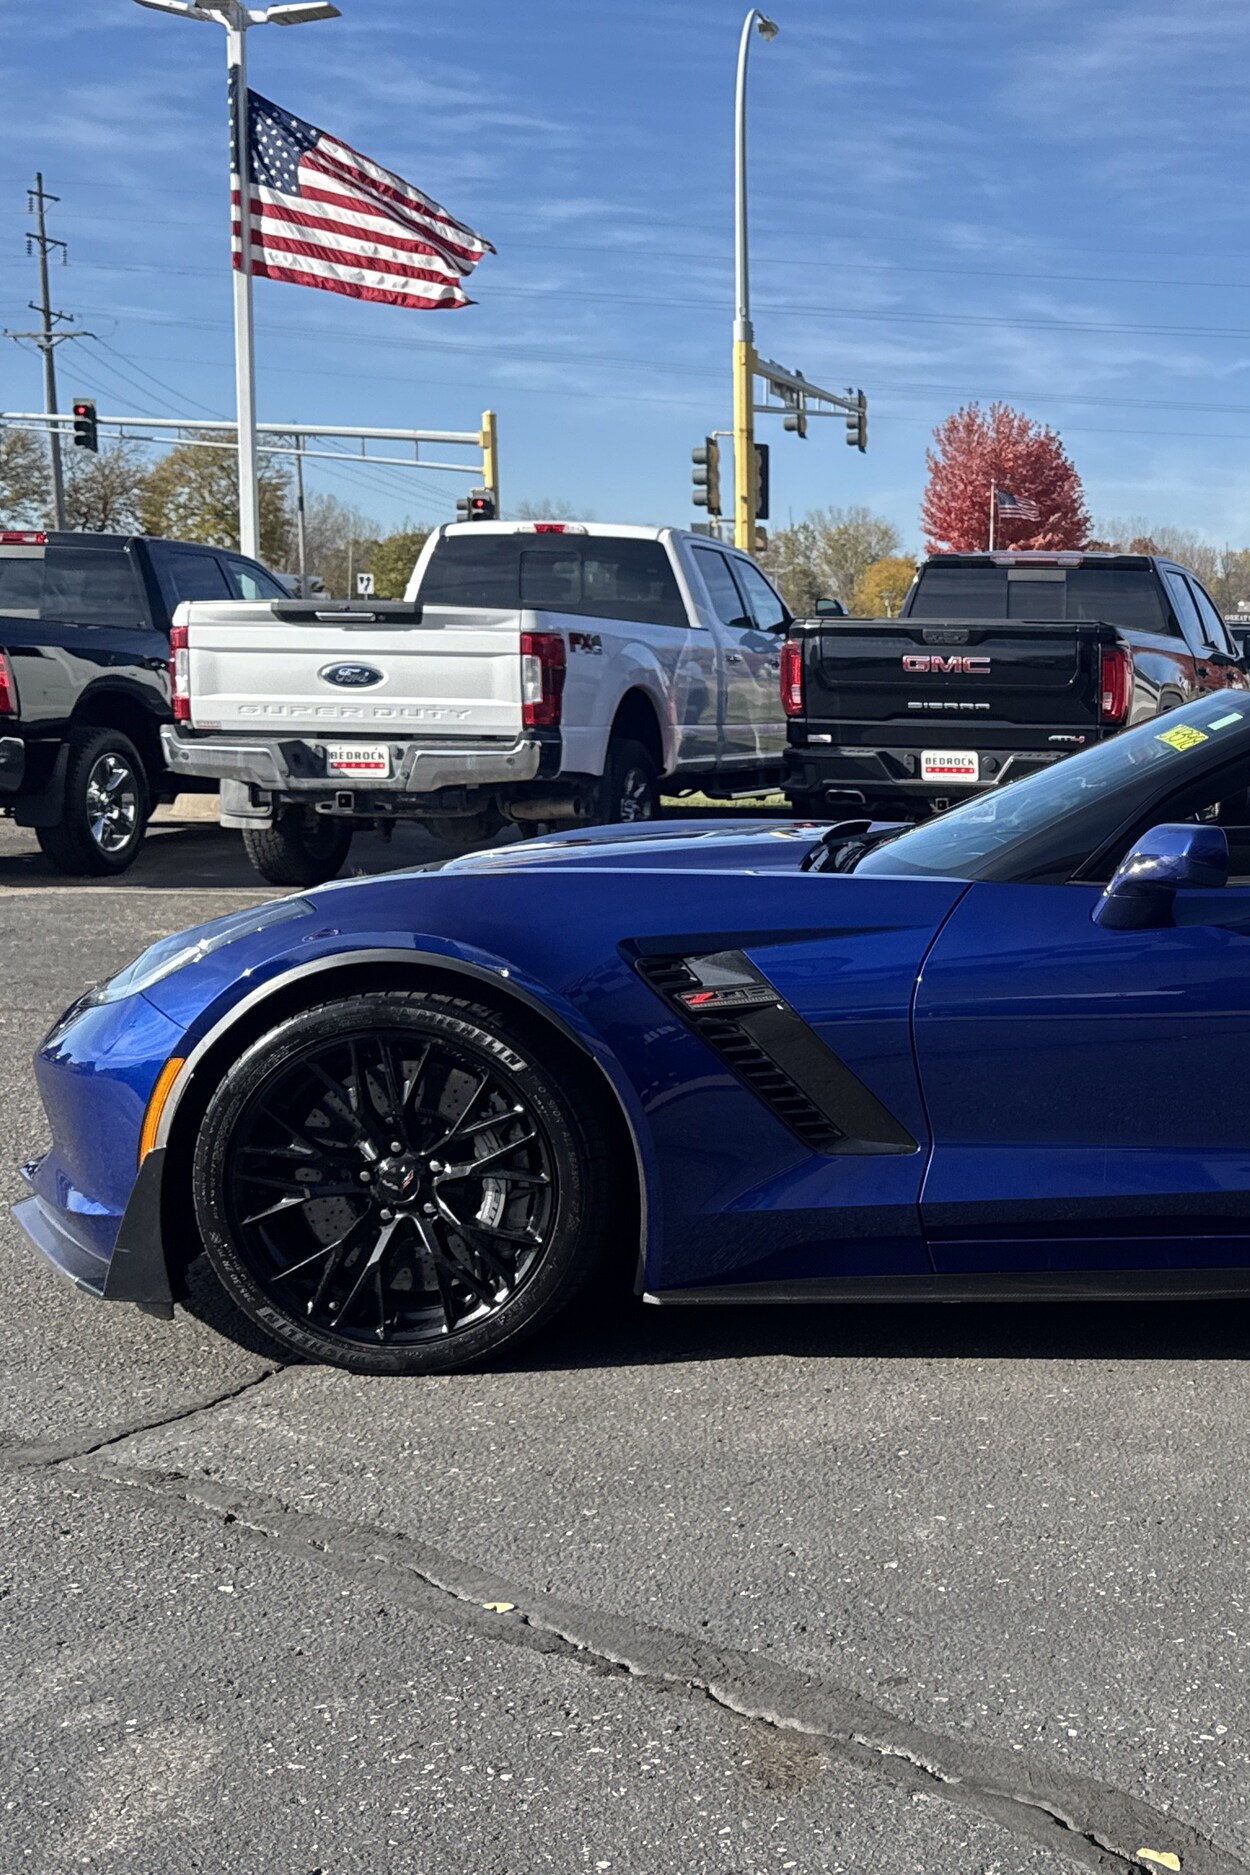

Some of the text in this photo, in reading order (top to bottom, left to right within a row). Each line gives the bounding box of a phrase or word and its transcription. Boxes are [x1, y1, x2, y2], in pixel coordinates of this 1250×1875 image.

[902, 655, 991, 674] GMC
[335, 667, 369, 683] Ford
[238, 705, 473, 720] SUPER DUTY
[330, 751, 385, 760] BEDROCK
[925, 757, 975, 766] BEDROCK
[416, 1009, 523, 1070] MICHELIN
